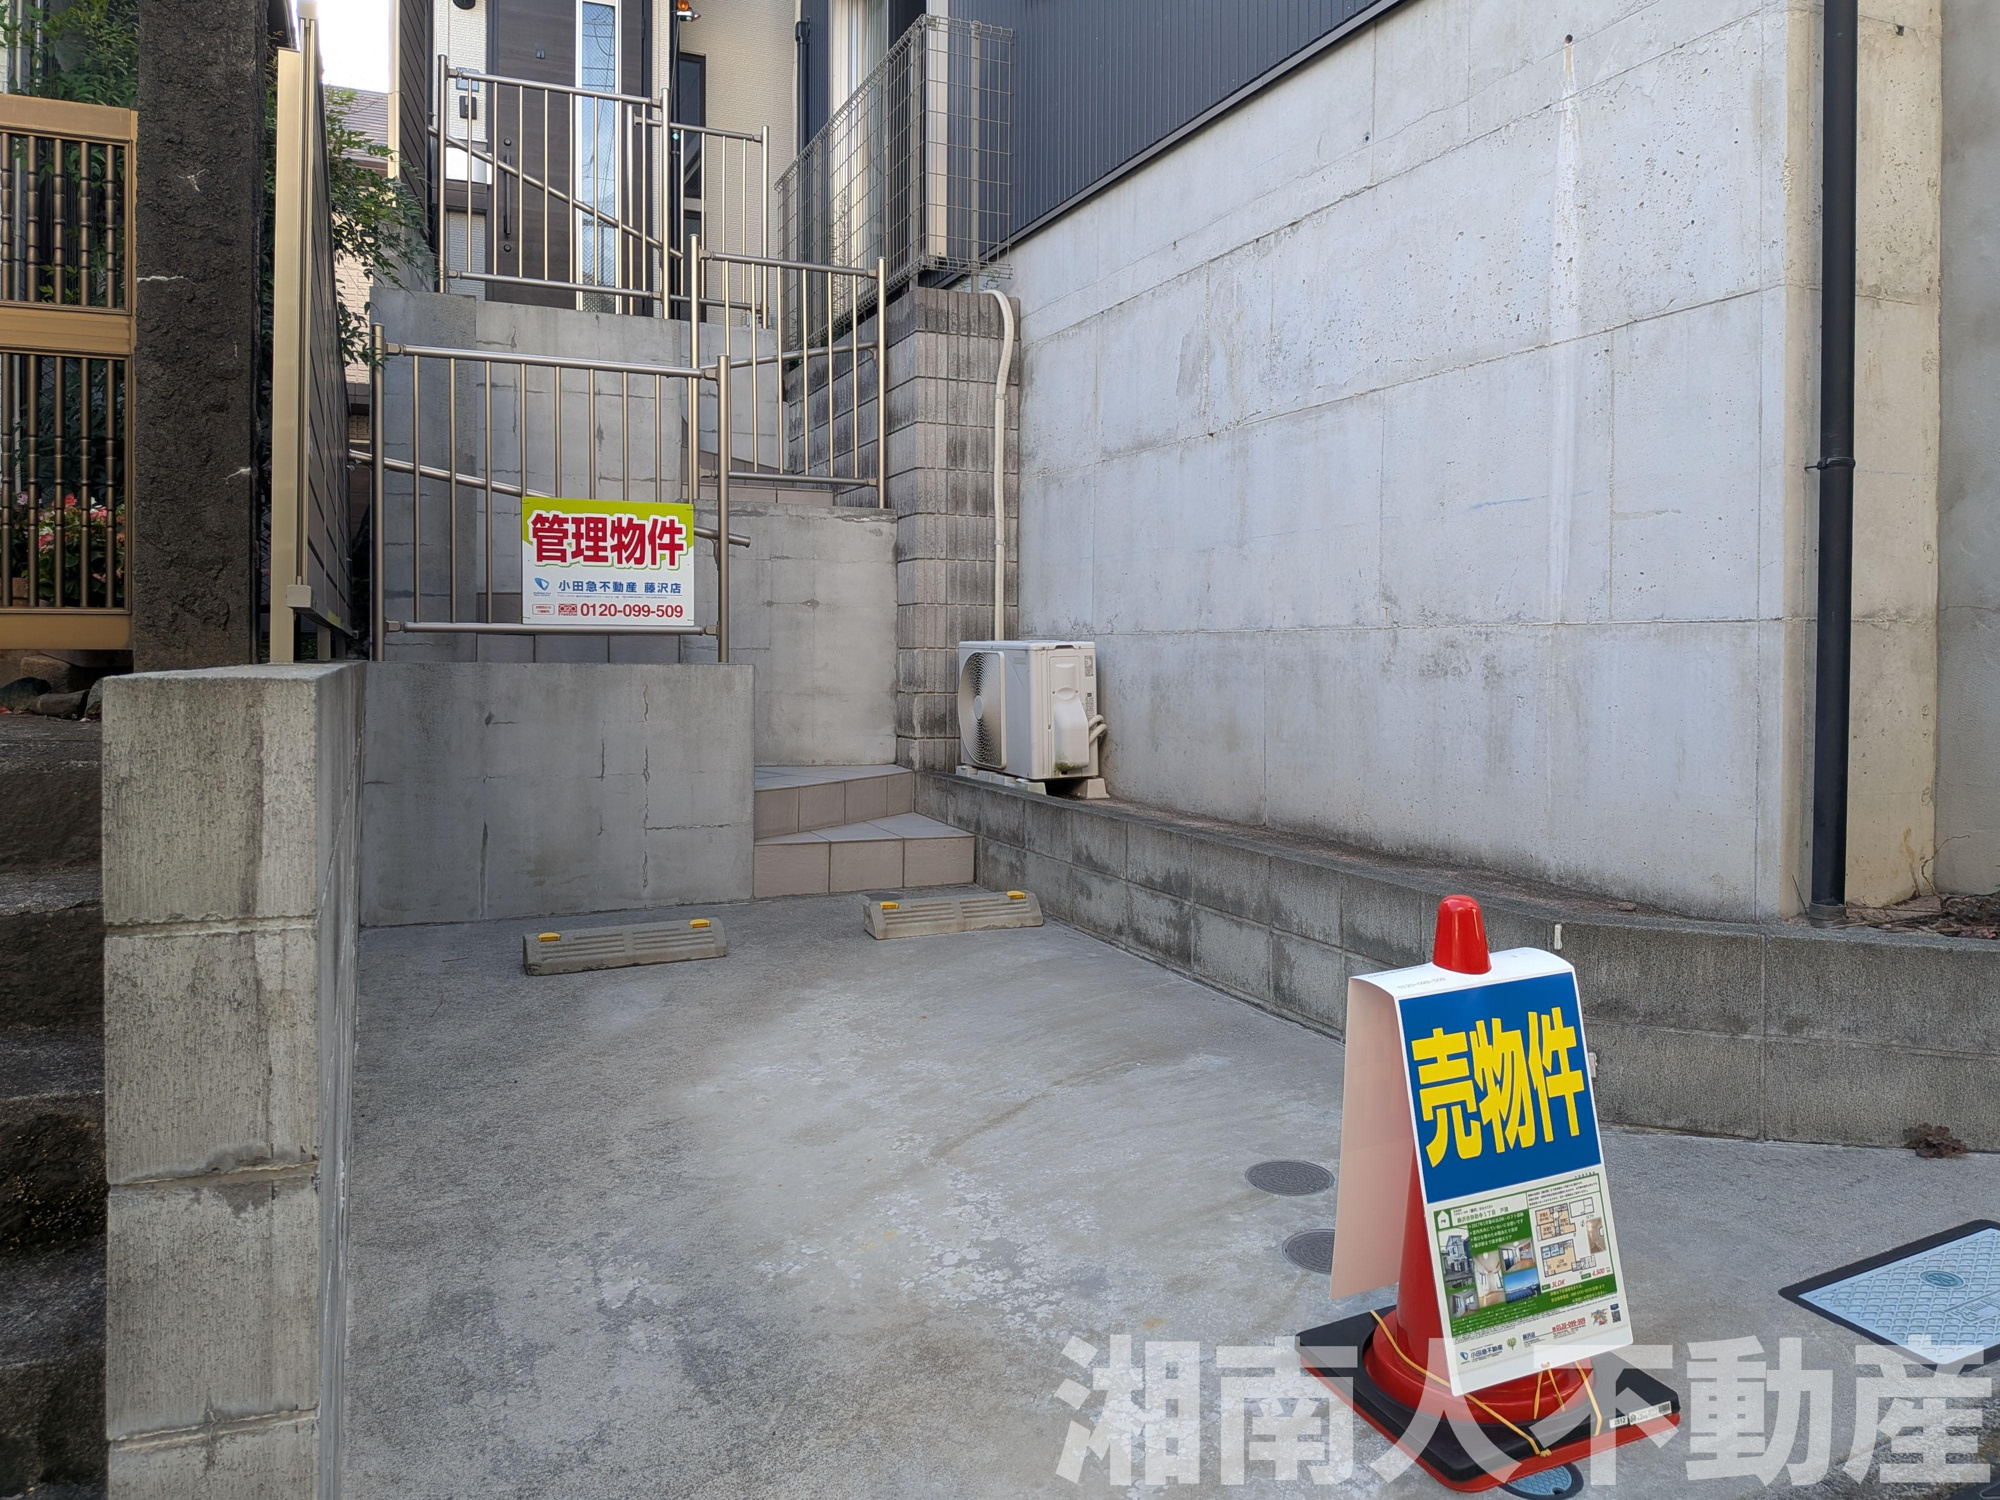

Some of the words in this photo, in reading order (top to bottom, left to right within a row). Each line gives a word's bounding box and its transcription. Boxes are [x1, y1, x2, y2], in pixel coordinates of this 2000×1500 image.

[531, 513, 684, 566] 管理物件
[558, 580, 638, 593] 小田急不動産
[644, 582, 682, 594] 藤沢店
[580, 603, 684, 618] 0120-099-509
[1411, 1006, 1585, 1168] 売物件
